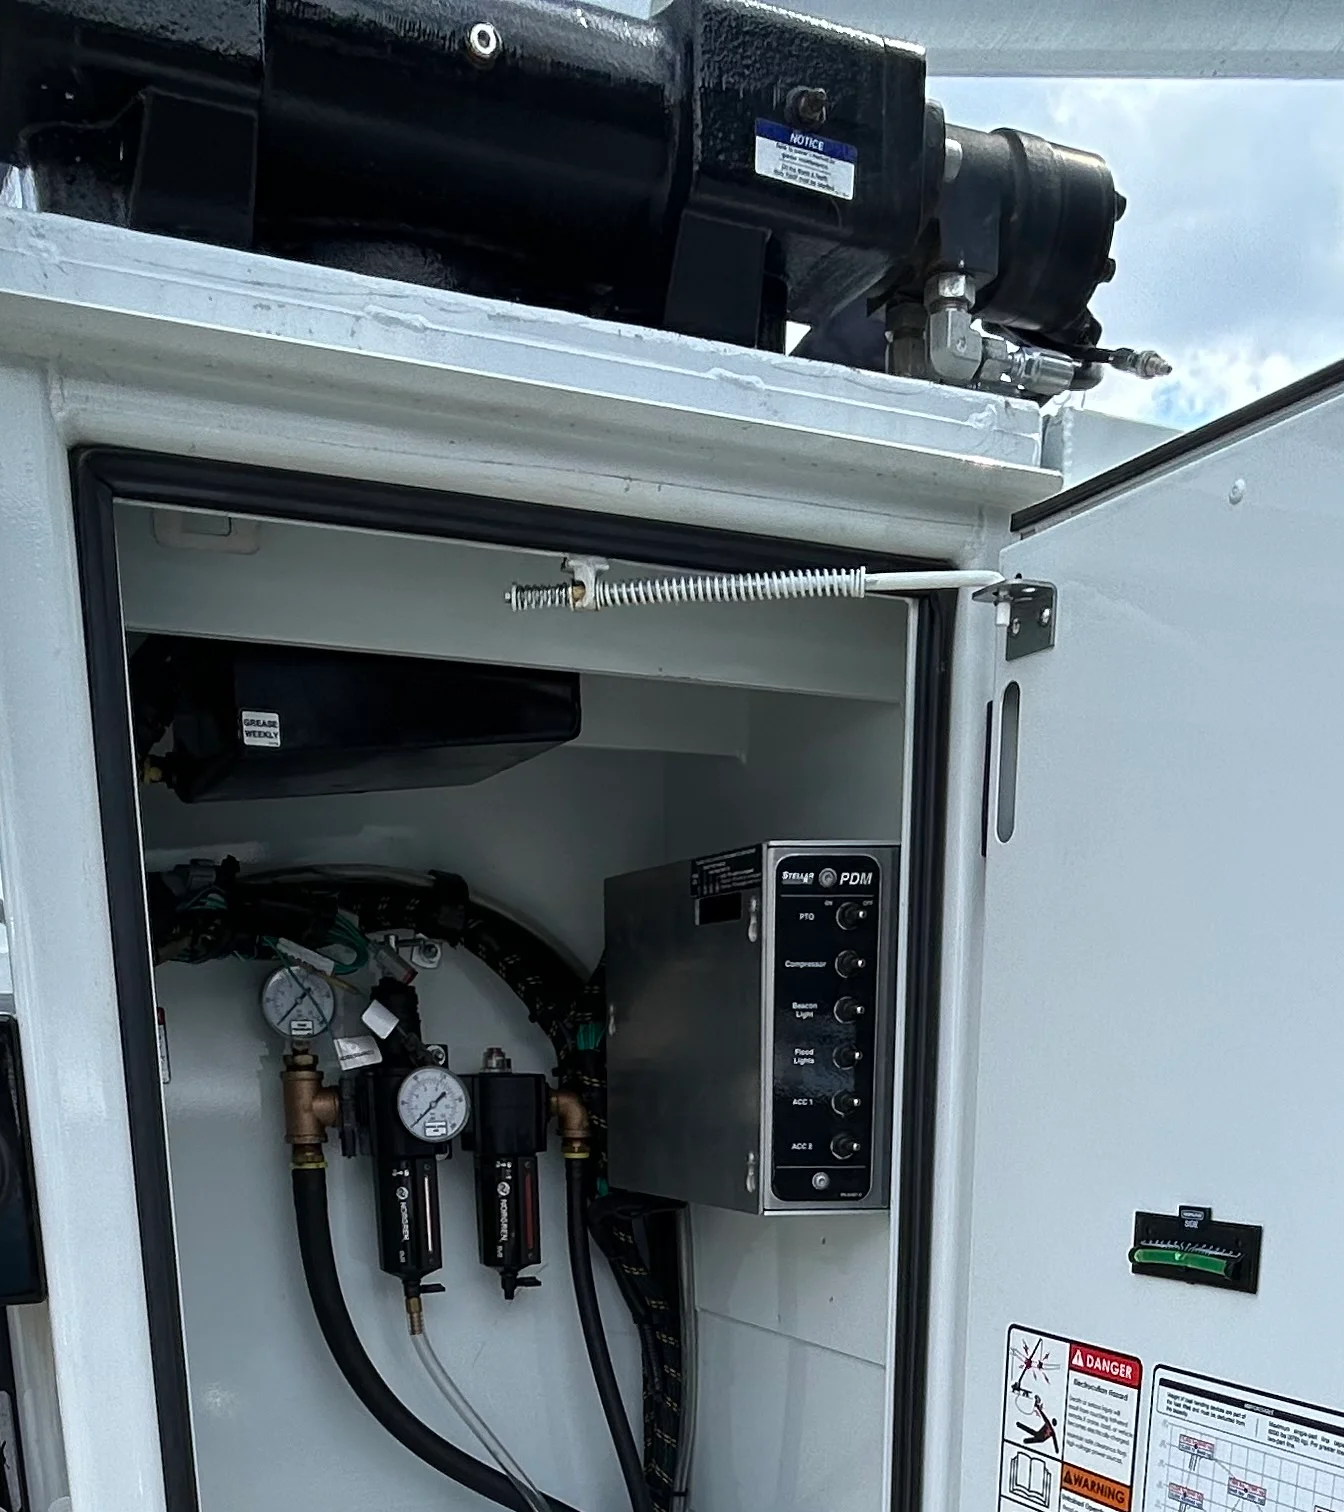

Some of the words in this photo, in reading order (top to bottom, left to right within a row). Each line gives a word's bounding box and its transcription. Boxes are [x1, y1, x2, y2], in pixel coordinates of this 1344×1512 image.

[790, 132, 825, 152] NOTICE
[839, 872, 873, 885] PDM
[784, 960, 827, 968] Compressor
[792, 1002, 818, 1010] Beacon
[796, 1010, 813, 1019] Light
[1086, 1354, 1133, 1380] DANGER
[1073, 1475, 1125, 1504] WARNING
